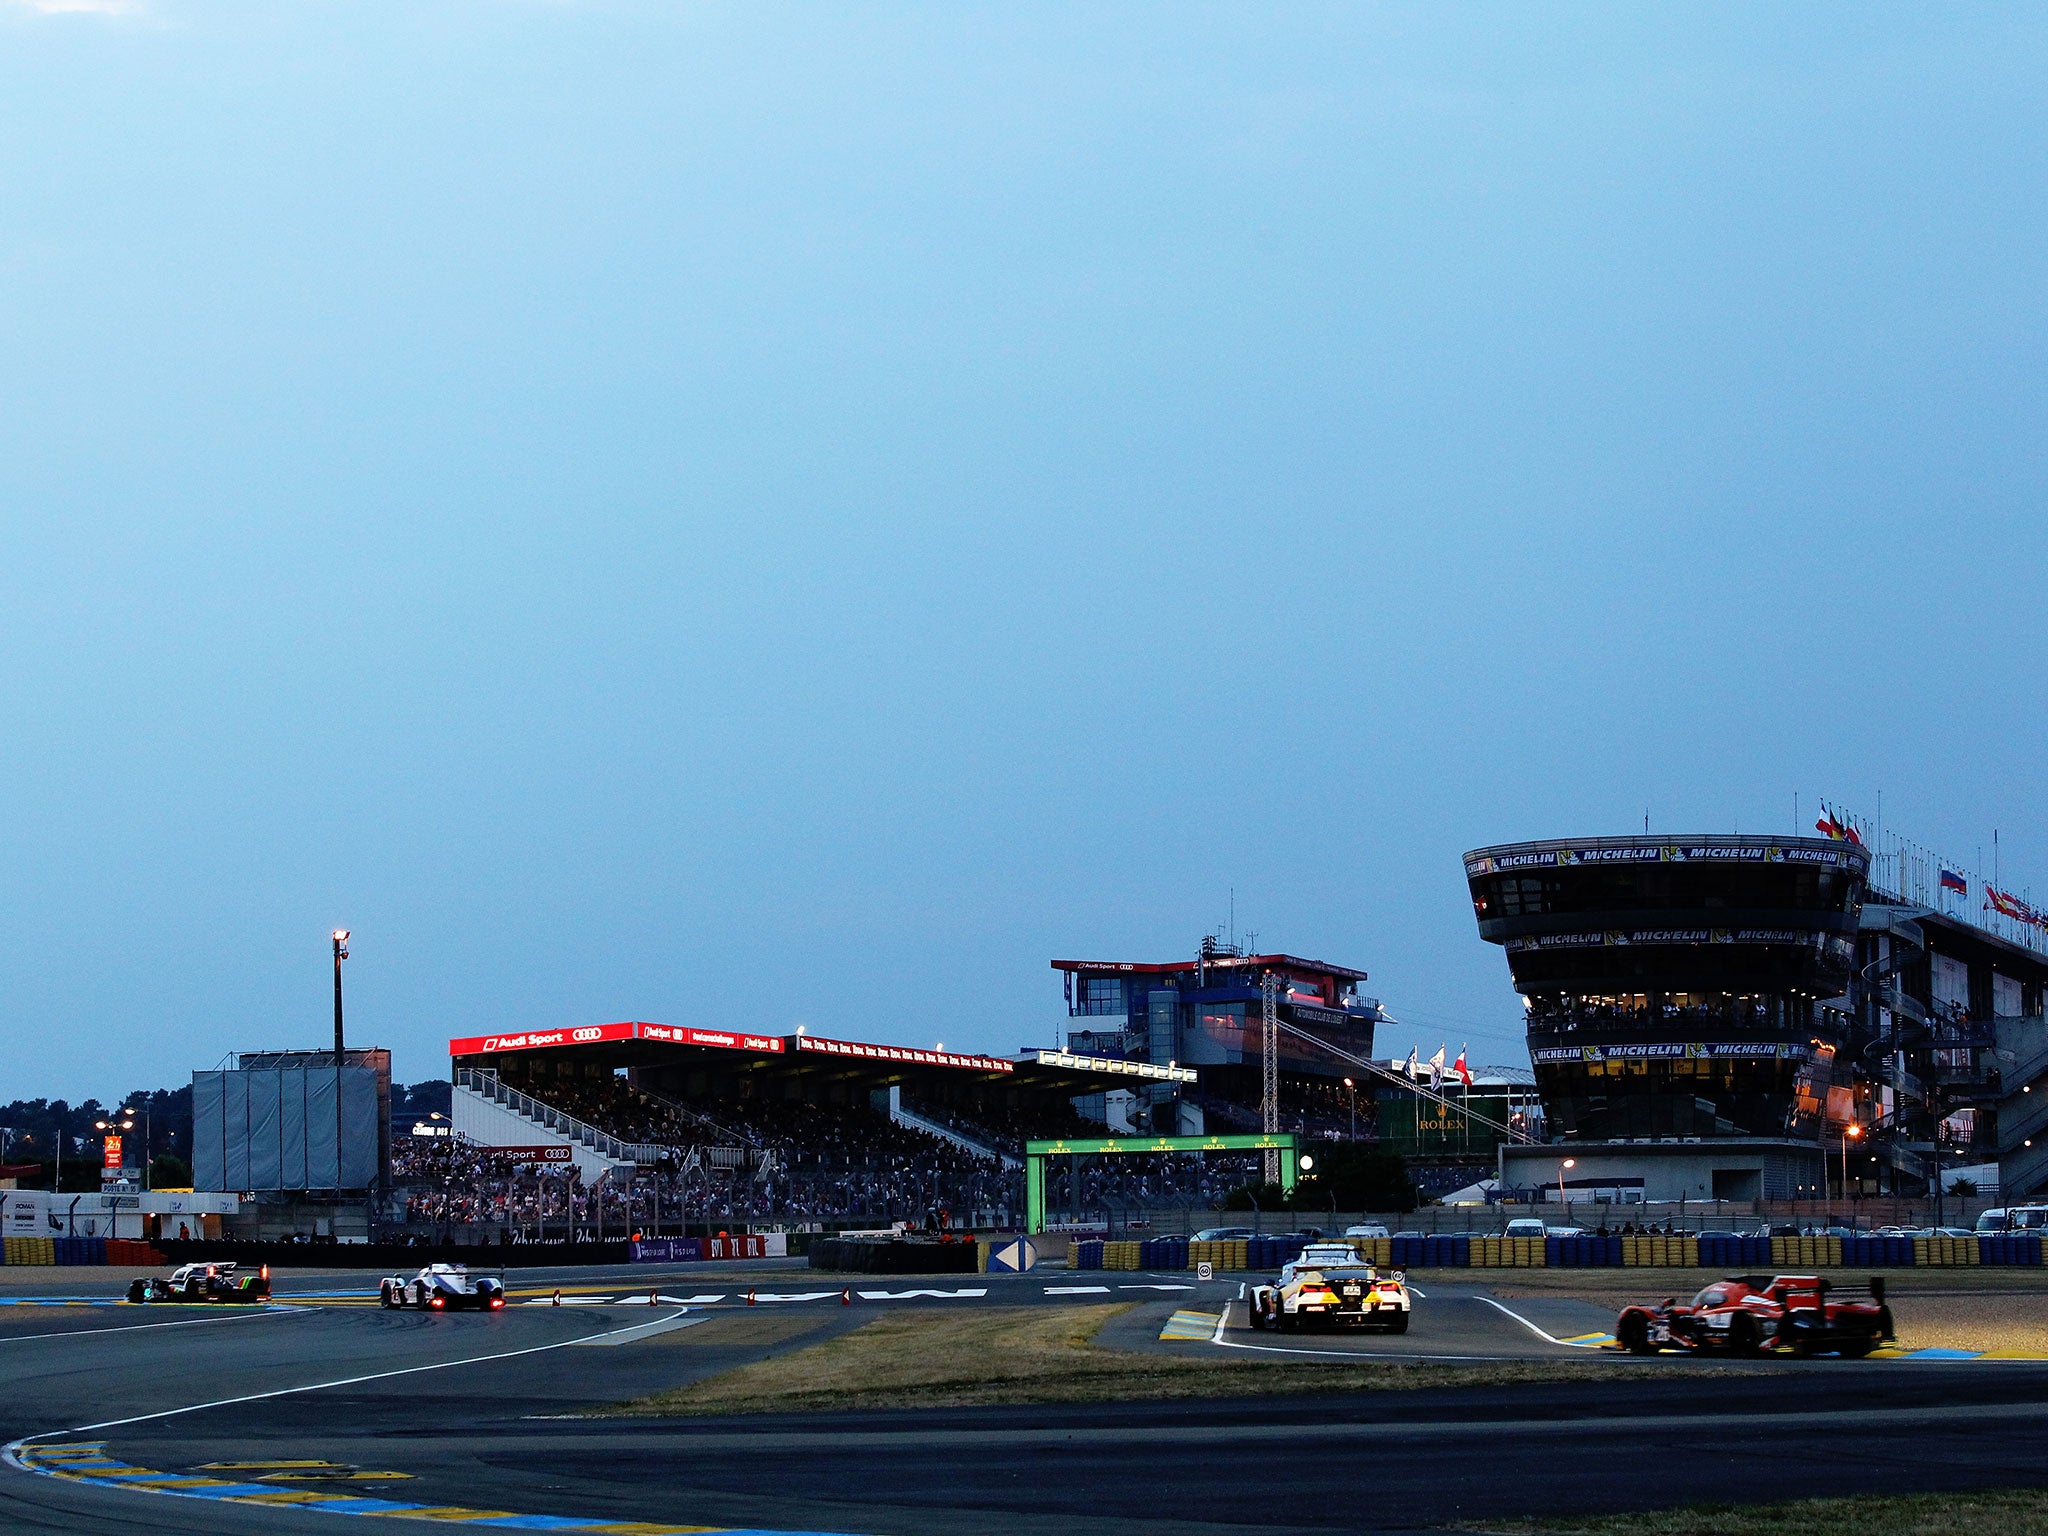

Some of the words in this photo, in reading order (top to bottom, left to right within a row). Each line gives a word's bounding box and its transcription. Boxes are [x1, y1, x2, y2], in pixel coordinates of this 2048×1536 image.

[1500, 852, 1555, 866] MICHELIN
[1583, 848, 1658, 860] MICHELIN
[1690, 848, 1762, 858] MICHELIN
[1788, 850, 1838, 862] MICHELIN
[1540, 933, 1602, 945] MICHELIN
[1633, 930, 1707, 940] MICHELIN
[1737, 930, 1795, 940] MICHELIN
[497, 1035, 526, 1049] Audi
[527, 1032, 564, 1048] Sport
[1537, 1049, 1581, 1060] MICHELIN
[1608, 1045, 1684, 1056] MICHELIN
[1714, 1044, 1777, 1054] MICHELIN
[1419, 1119, 1465, 1130] ROLEX
[506, 1150, 536, 1160] Sport
[103, 1184, 121, 1192] POSTE
[1200, 1267, 1209, 1275] 60
